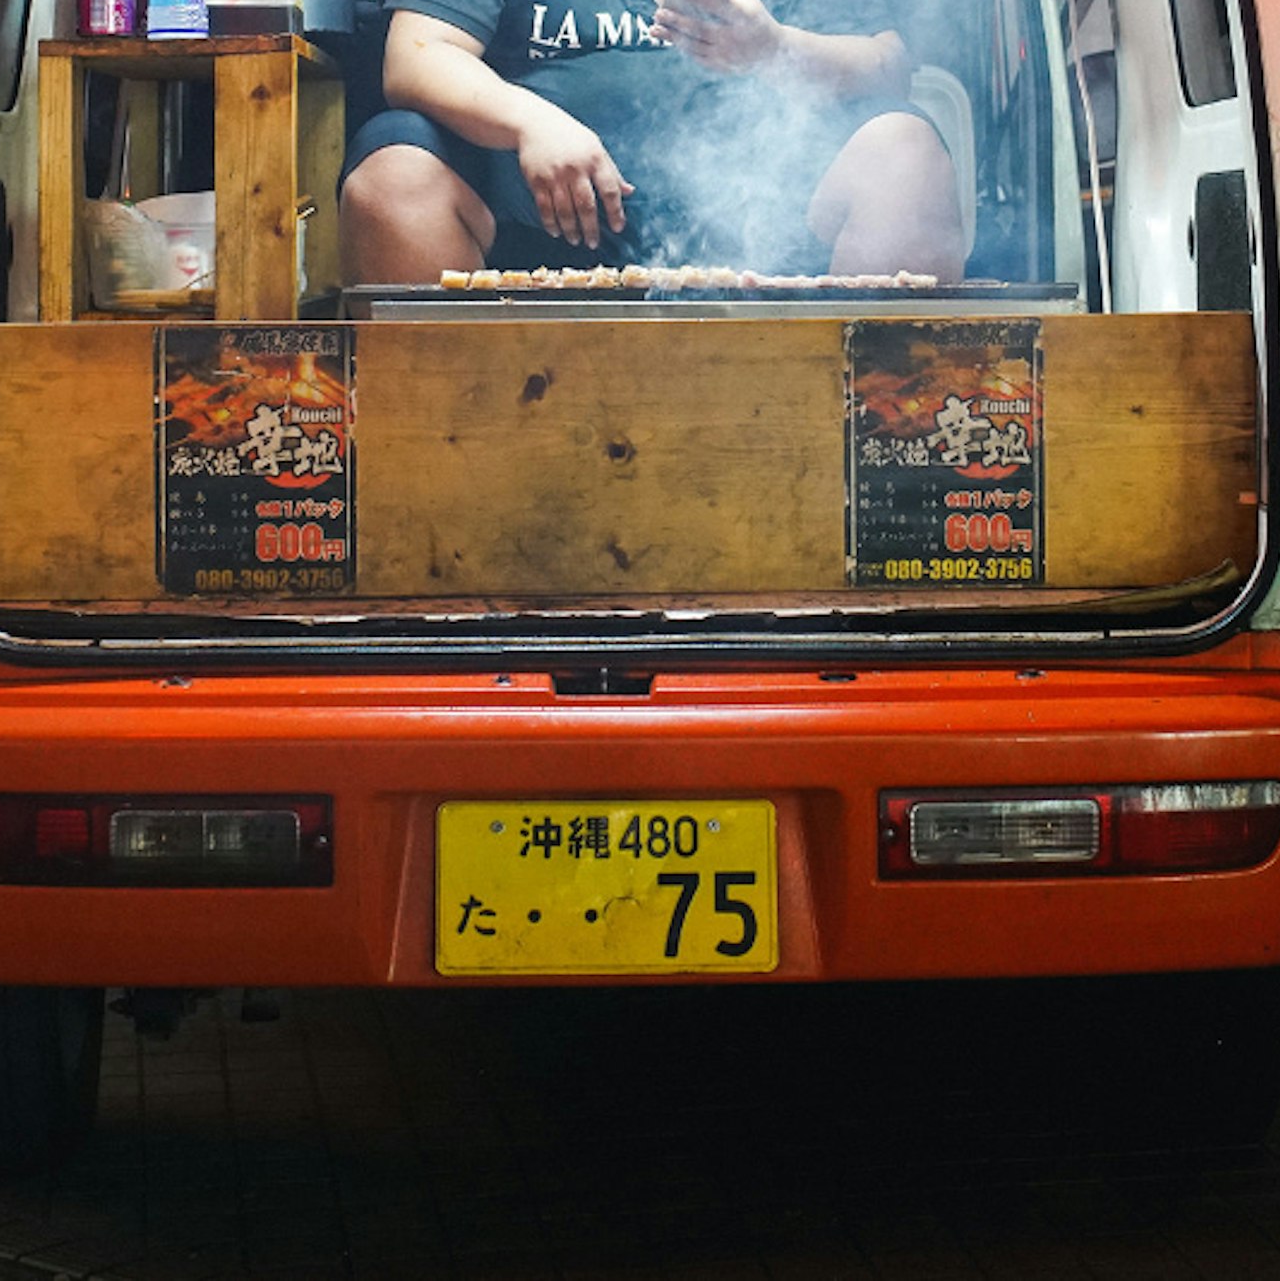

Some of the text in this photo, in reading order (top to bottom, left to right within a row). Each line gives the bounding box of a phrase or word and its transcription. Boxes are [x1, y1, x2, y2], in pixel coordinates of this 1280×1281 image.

[528, 3, 674, 49] LA MA
[980, 398, 1031, 415] Kouchi
[255, 522, 346, 562] 600円
[944, 513, 1033, 553] 600円
[195, 568, 344, 591] 080-3902-3756
[884, 558, 1033, 580] 080-3902-3756
